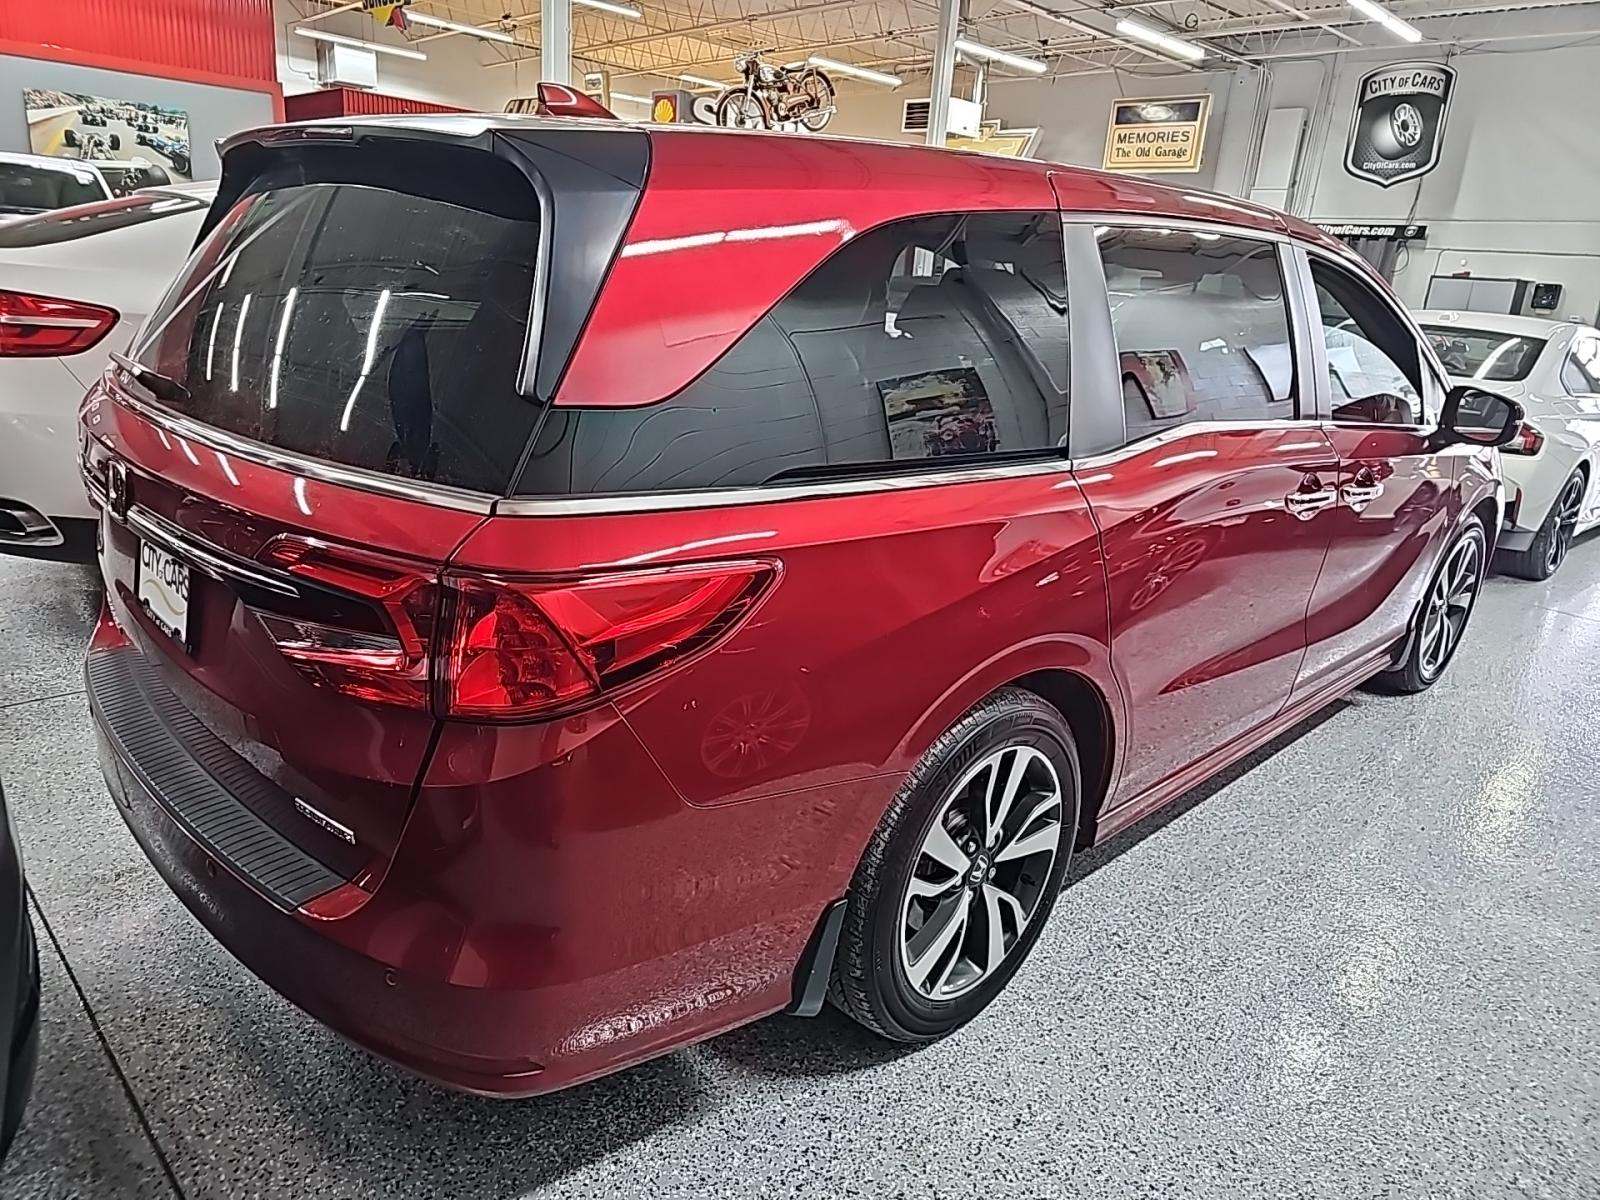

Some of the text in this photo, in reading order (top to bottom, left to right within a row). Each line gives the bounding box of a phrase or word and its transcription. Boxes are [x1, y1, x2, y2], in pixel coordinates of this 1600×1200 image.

[1369, 76, 1397, 94] CITY
[1398, 77, 1410, 88] OF
[1411, 72, 1444, 91] CARS
[1116, 130, 1190, 144] MEMORIES
[1115, 146, 1188, 158] The Old Garage
[142, 541, 161, 577] CITY
[163, 558, 190, 602] CARS
